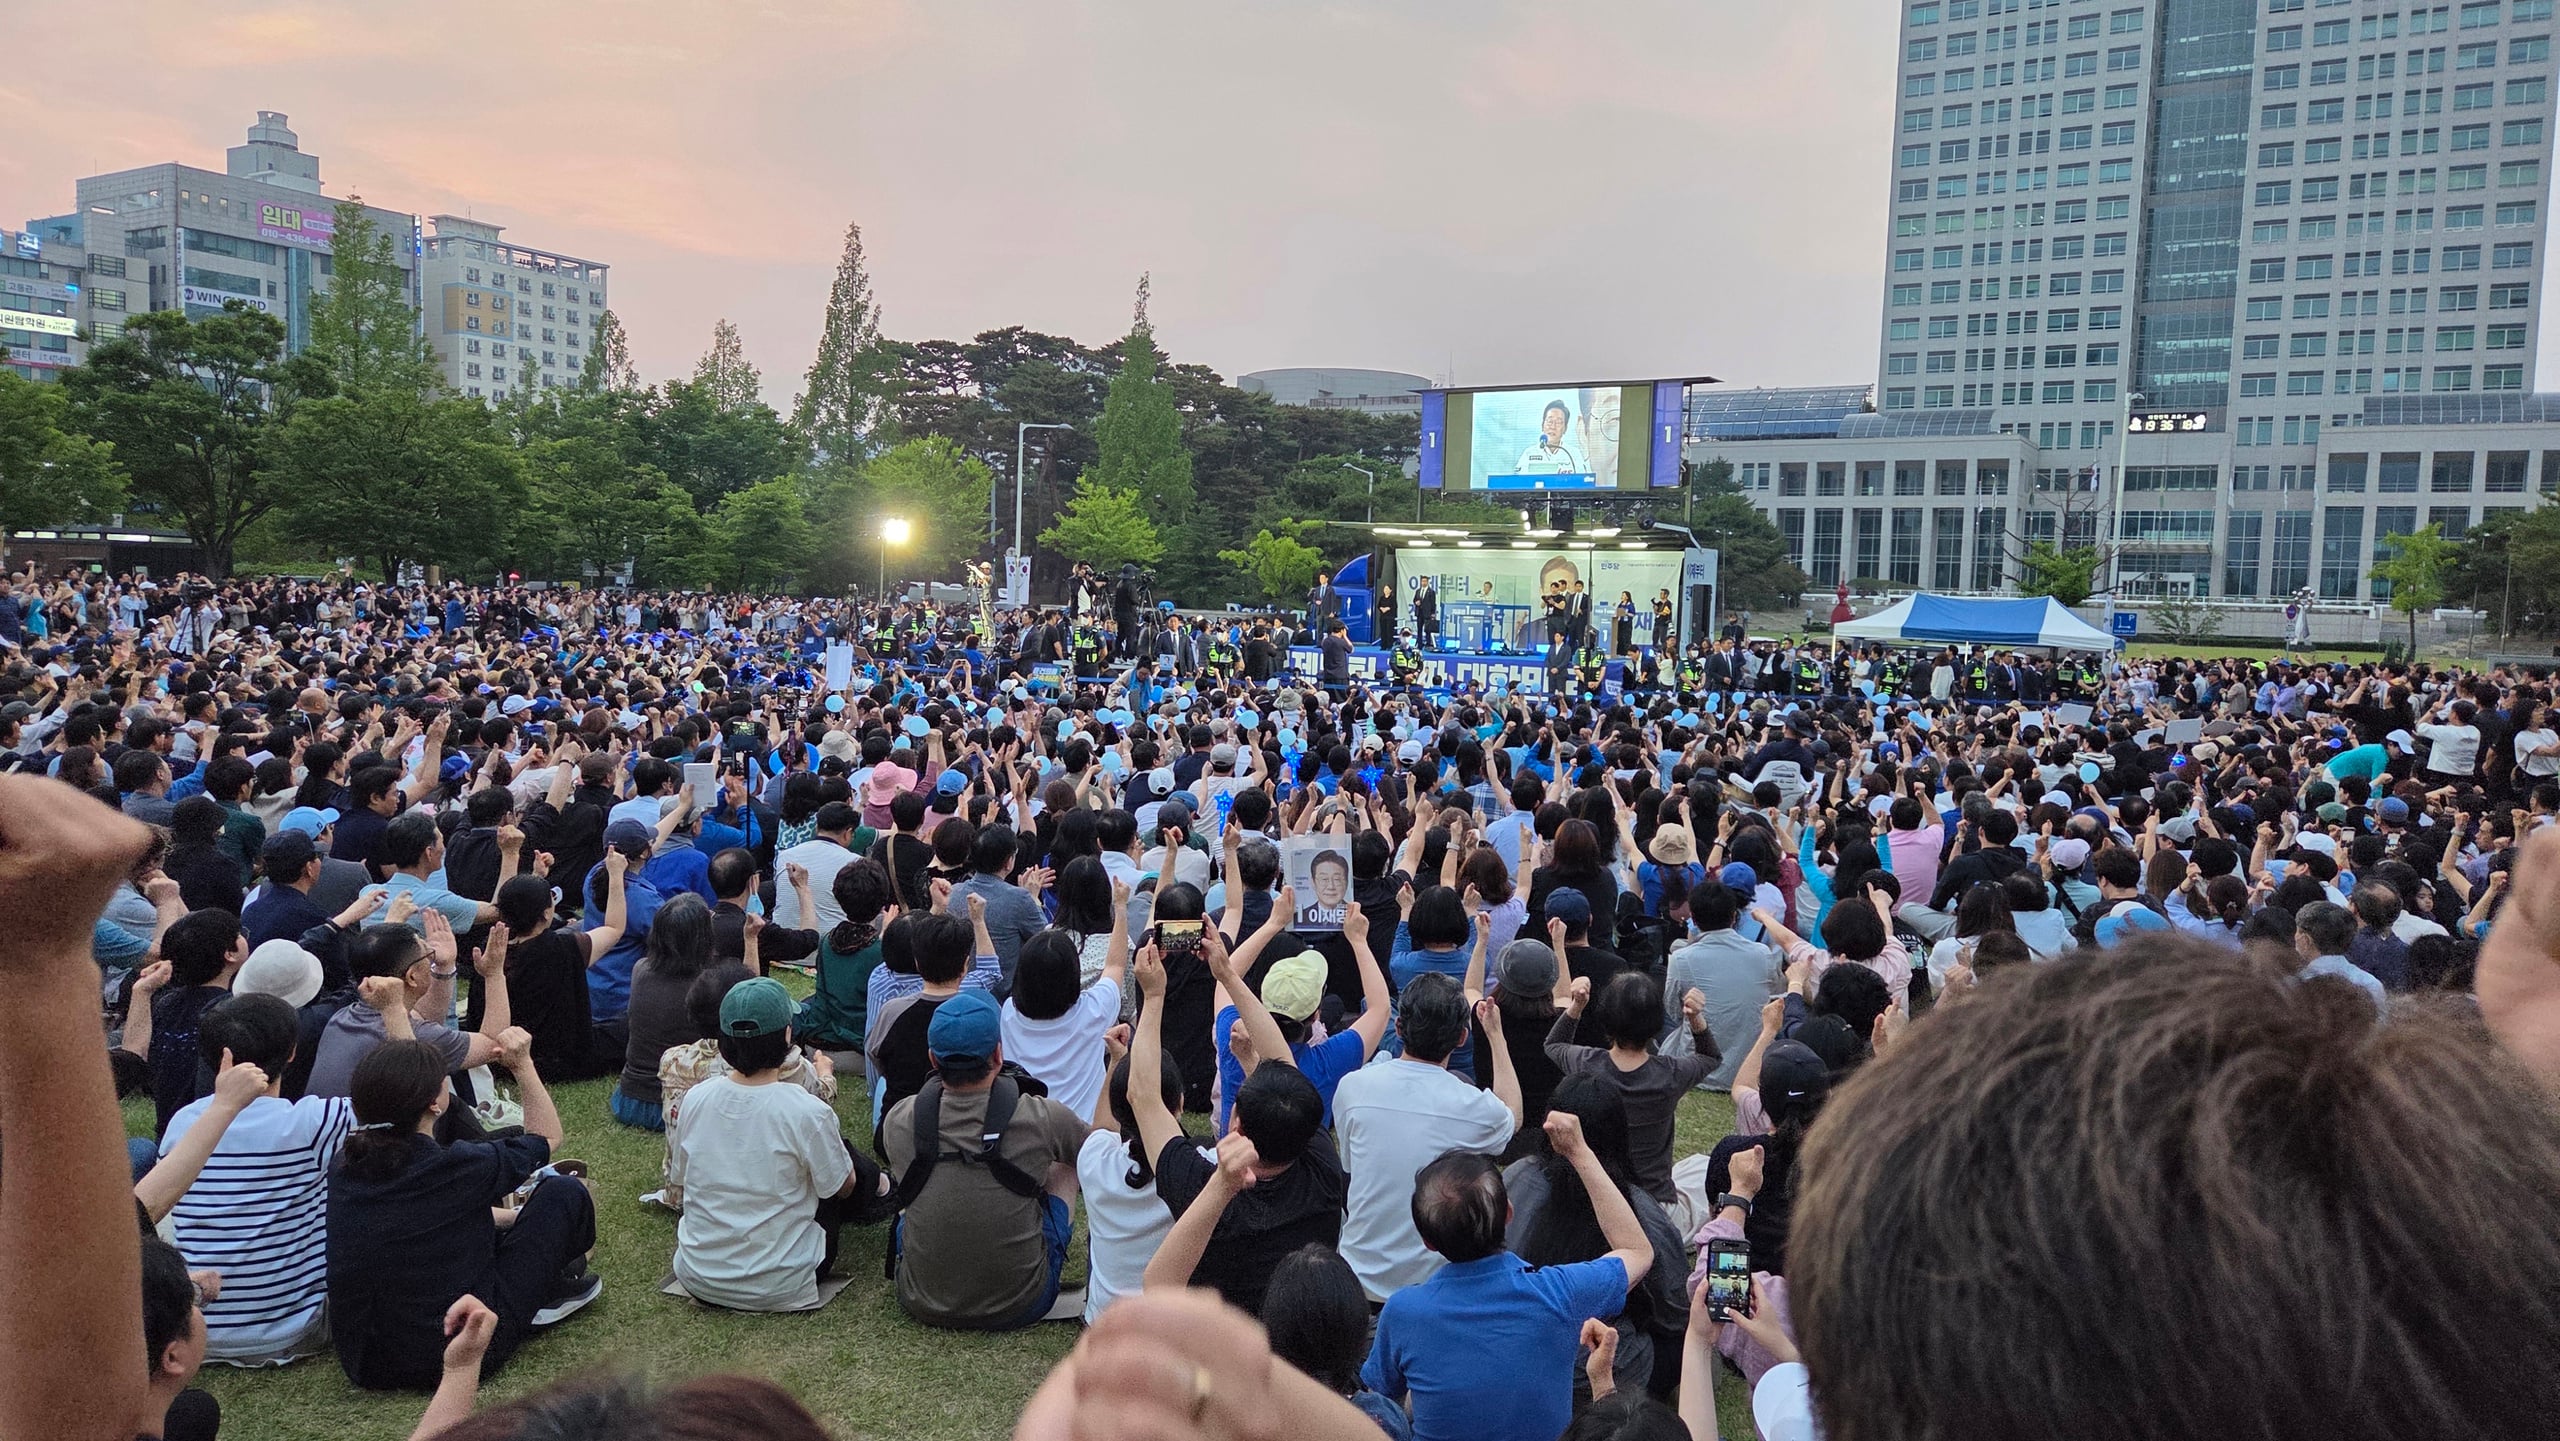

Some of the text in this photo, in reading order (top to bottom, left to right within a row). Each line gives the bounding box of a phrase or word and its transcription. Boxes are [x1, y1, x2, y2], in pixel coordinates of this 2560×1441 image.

[261, 205, 301, 231] 임대
[196, 291, 266, 311] WINRD
[1429, 431, 1436, 448] 1
[1665, 425, 1672, 443] 1
[1601, 562, 1620, 570] 민주당
